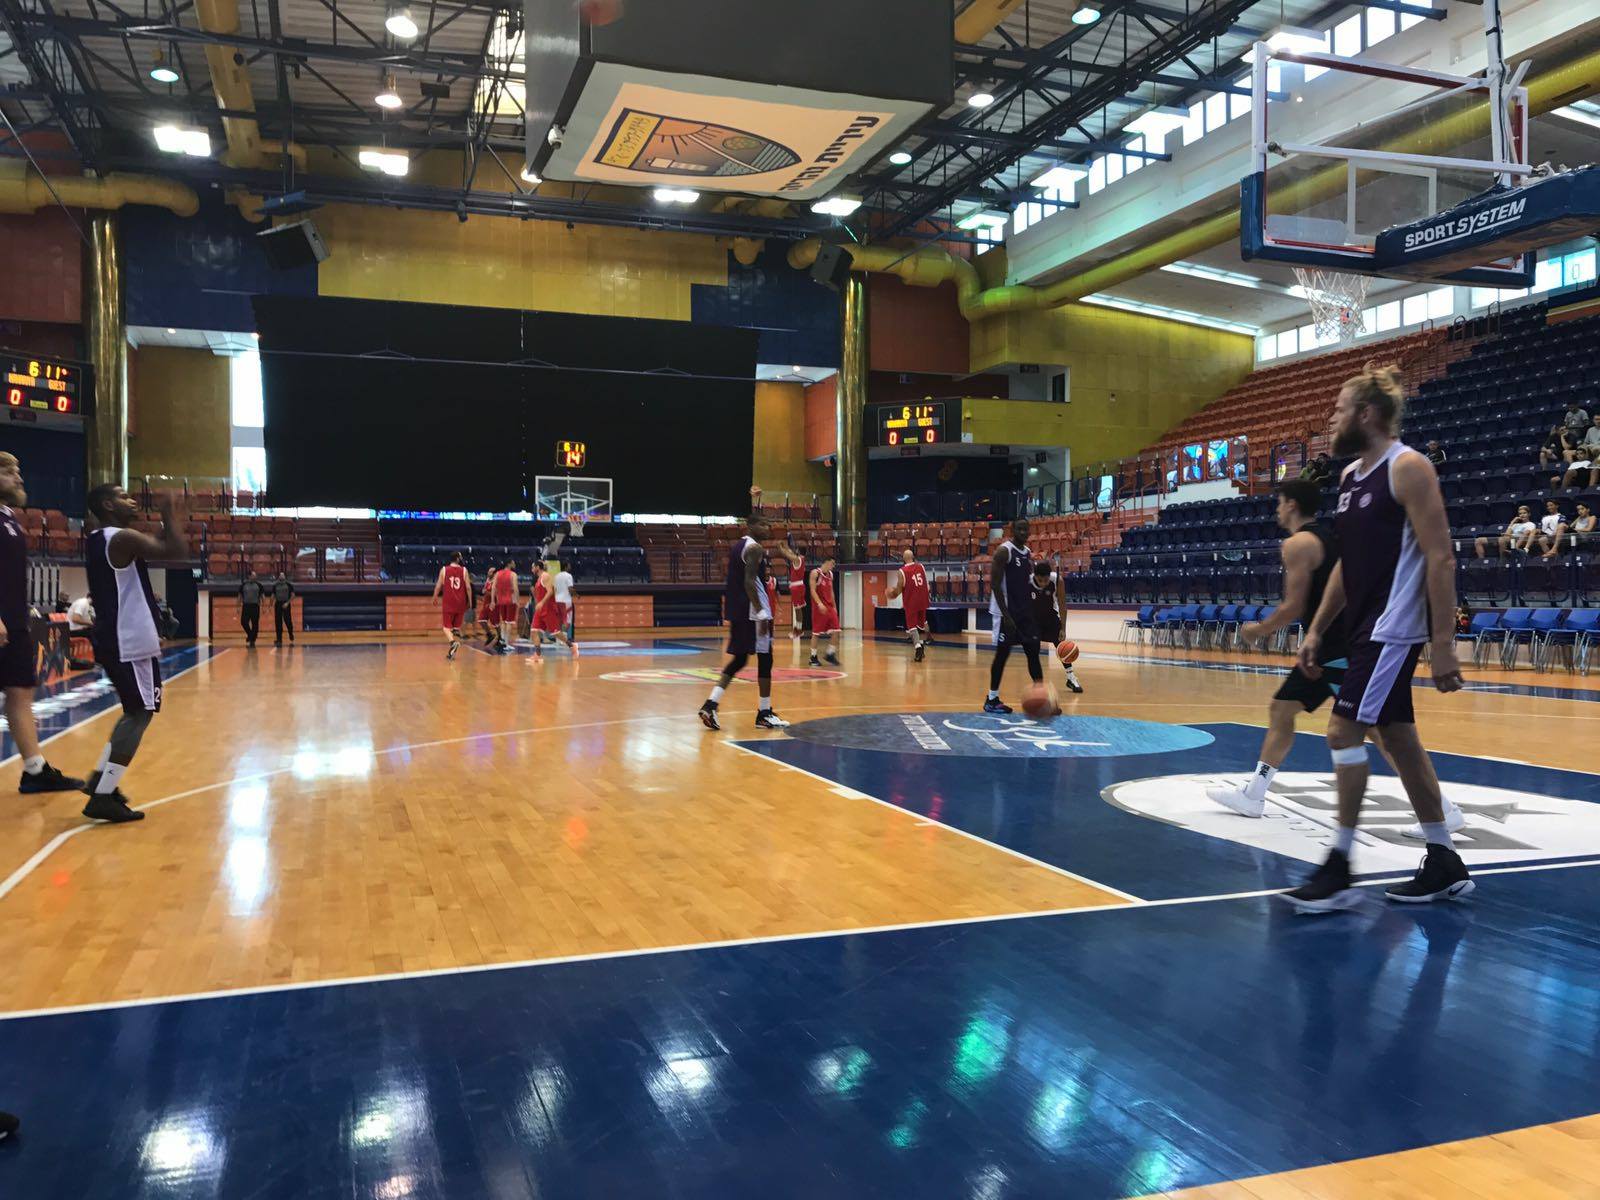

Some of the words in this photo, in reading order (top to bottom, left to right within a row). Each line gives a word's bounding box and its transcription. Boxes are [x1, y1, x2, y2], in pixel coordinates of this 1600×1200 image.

[814, 116, 880, 163] עיריית
[1405, 221, 1455, 248] SPORT
[1456, 198, 1527, 234] SYSTEM
[10, 389, 20, 405] 0
[58, 396, 68, 412] 0
[889, 432, 897, 444] 0
[926, 429, 934, 442] 0
[1016, 557, 1021, 567] 5
[449, 576, 460, 590] 13
[912, 572, 924, 586] 15
